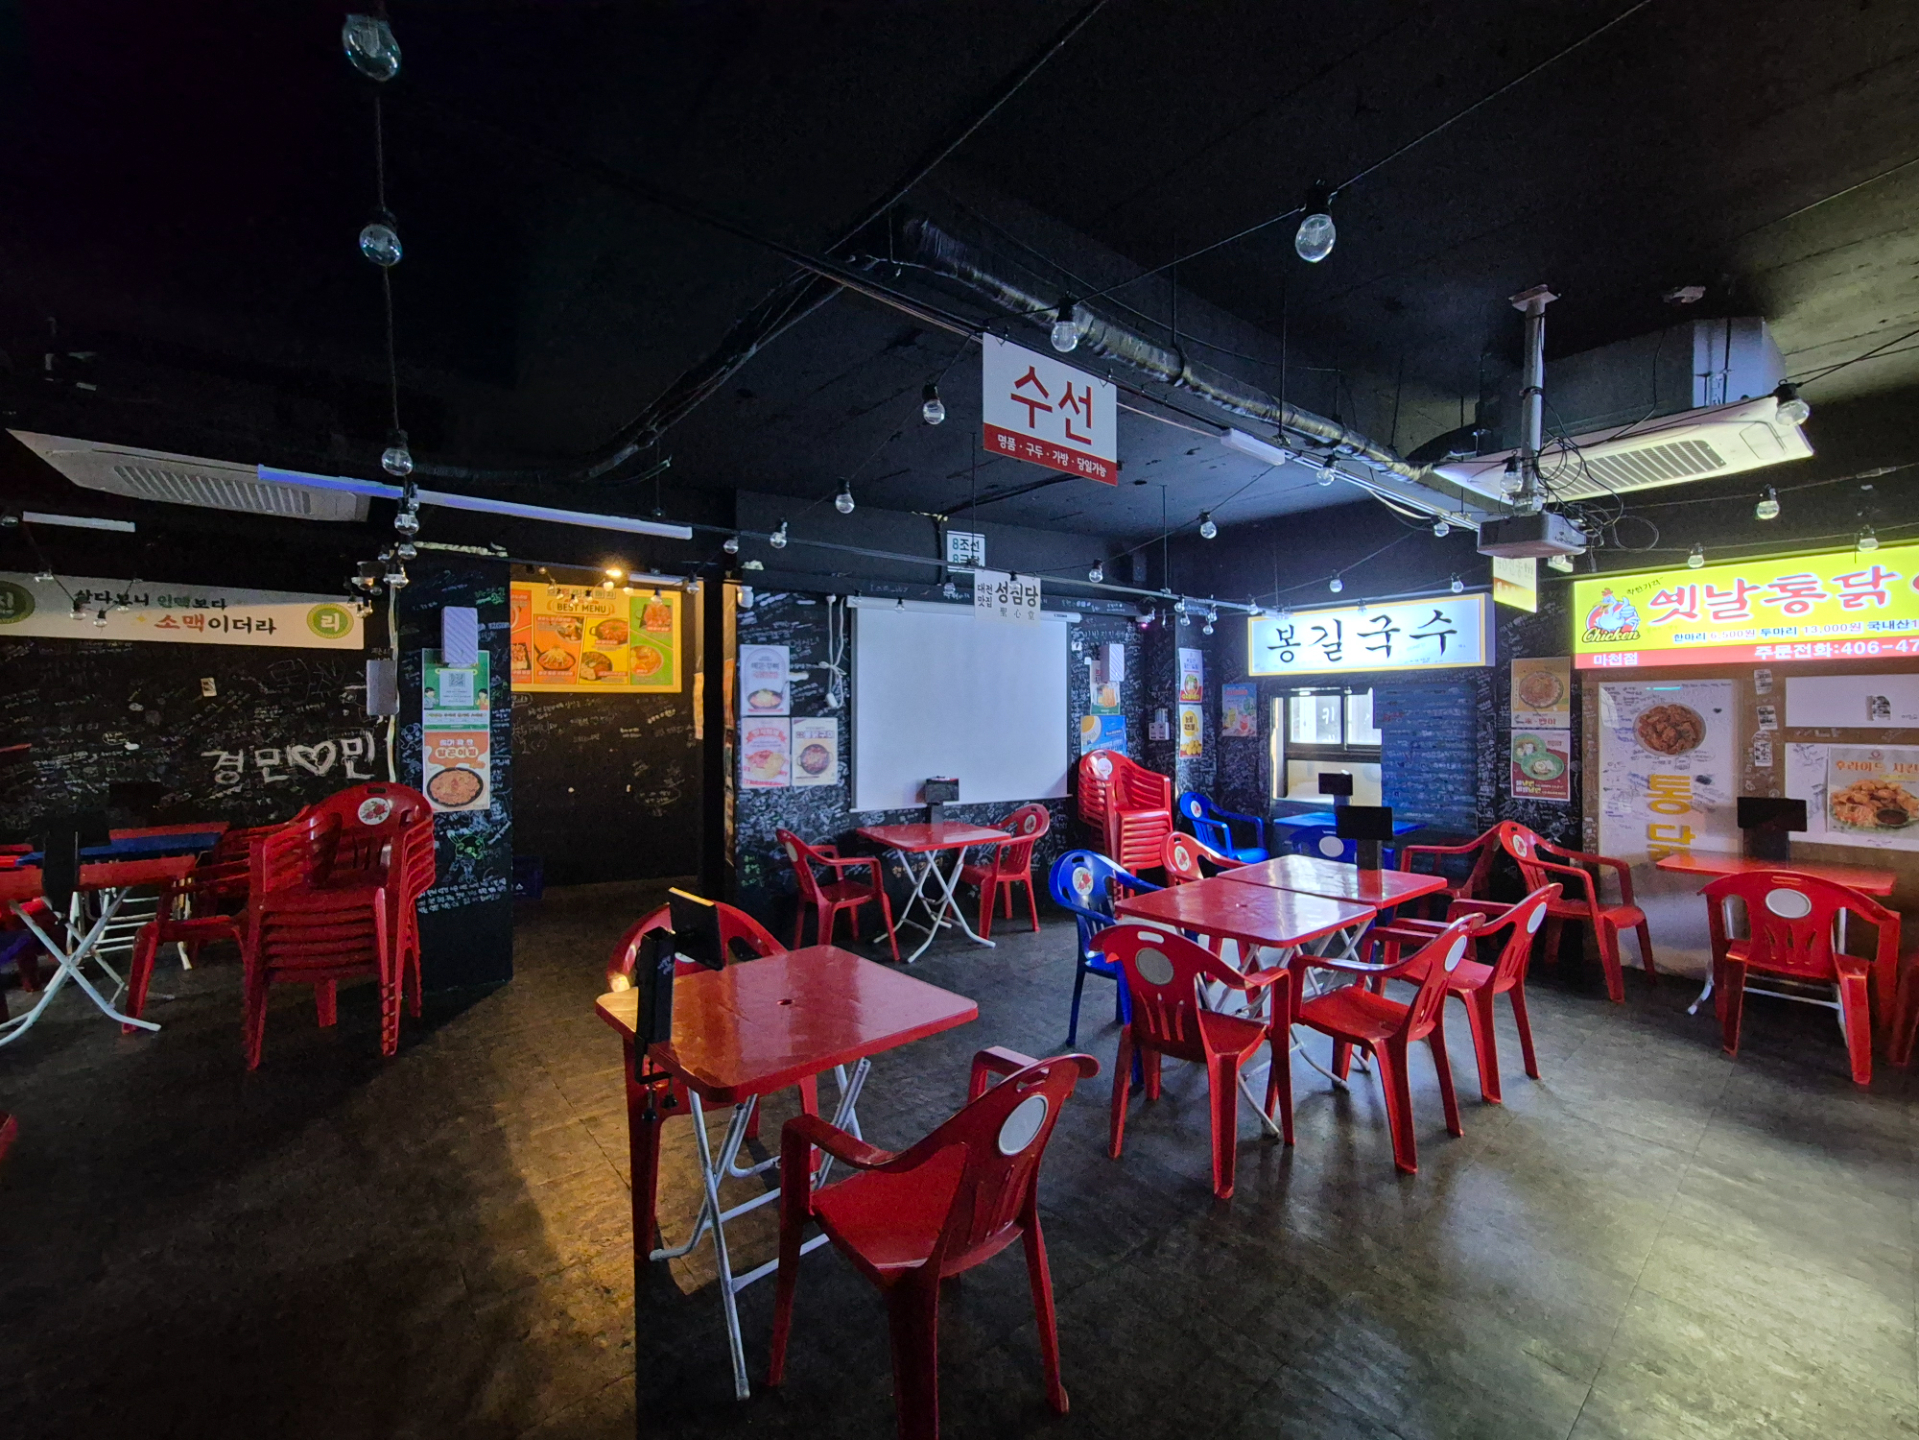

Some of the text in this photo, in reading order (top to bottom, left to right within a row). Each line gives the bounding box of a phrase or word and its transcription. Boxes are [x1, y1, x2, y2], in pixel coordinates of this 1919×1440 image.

[1010, 365, 1092, 446] 수선
[997, 434, 1107, 478] 명품 구두 가방 당일가능
[952, 538, 980, 553] 8조선
[995, 581, 1039, 608] 성심당
[1649, 564, 1899, 624] 옛날통닭
[557, 603, 606, 613] BEST MENU
[154, 612, 340, 636] 소맥이더라 리
[1267, 608, 1458, 663] 봉길국수
[1582, 627, 1641, 644] Chicken
[1673, 632, 1706, 643] 한마리
[1760, 626, 1798, 638] 두마리
[1593, 652, 1639, 667] 마천점
